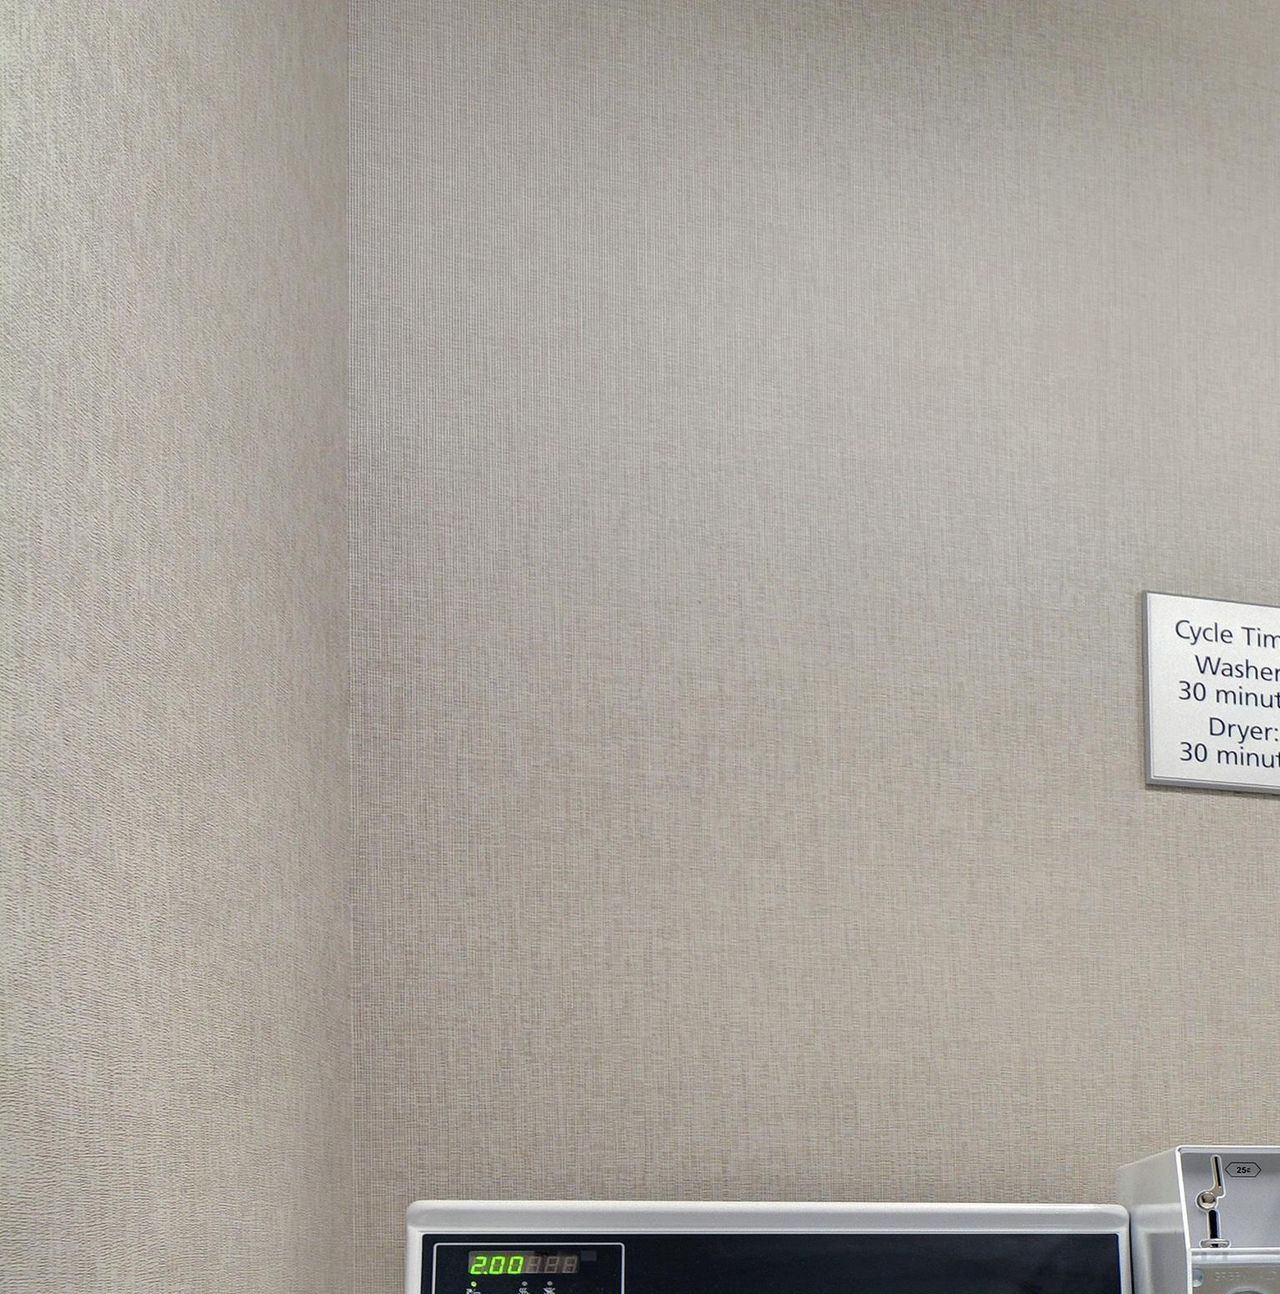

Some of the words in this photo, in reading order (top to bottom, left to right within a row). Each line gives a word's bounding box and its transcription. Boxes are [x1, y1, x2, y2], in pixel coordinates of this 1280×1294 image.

[1175, 619, 1234, 646] Cycle
[1178, 680, 1207, 702] 30
[1209, 717, 1279, 744] Dryer:
[1180, 741, 1208, 763] 30
[470, 1255, 524, 1275] 2.00
